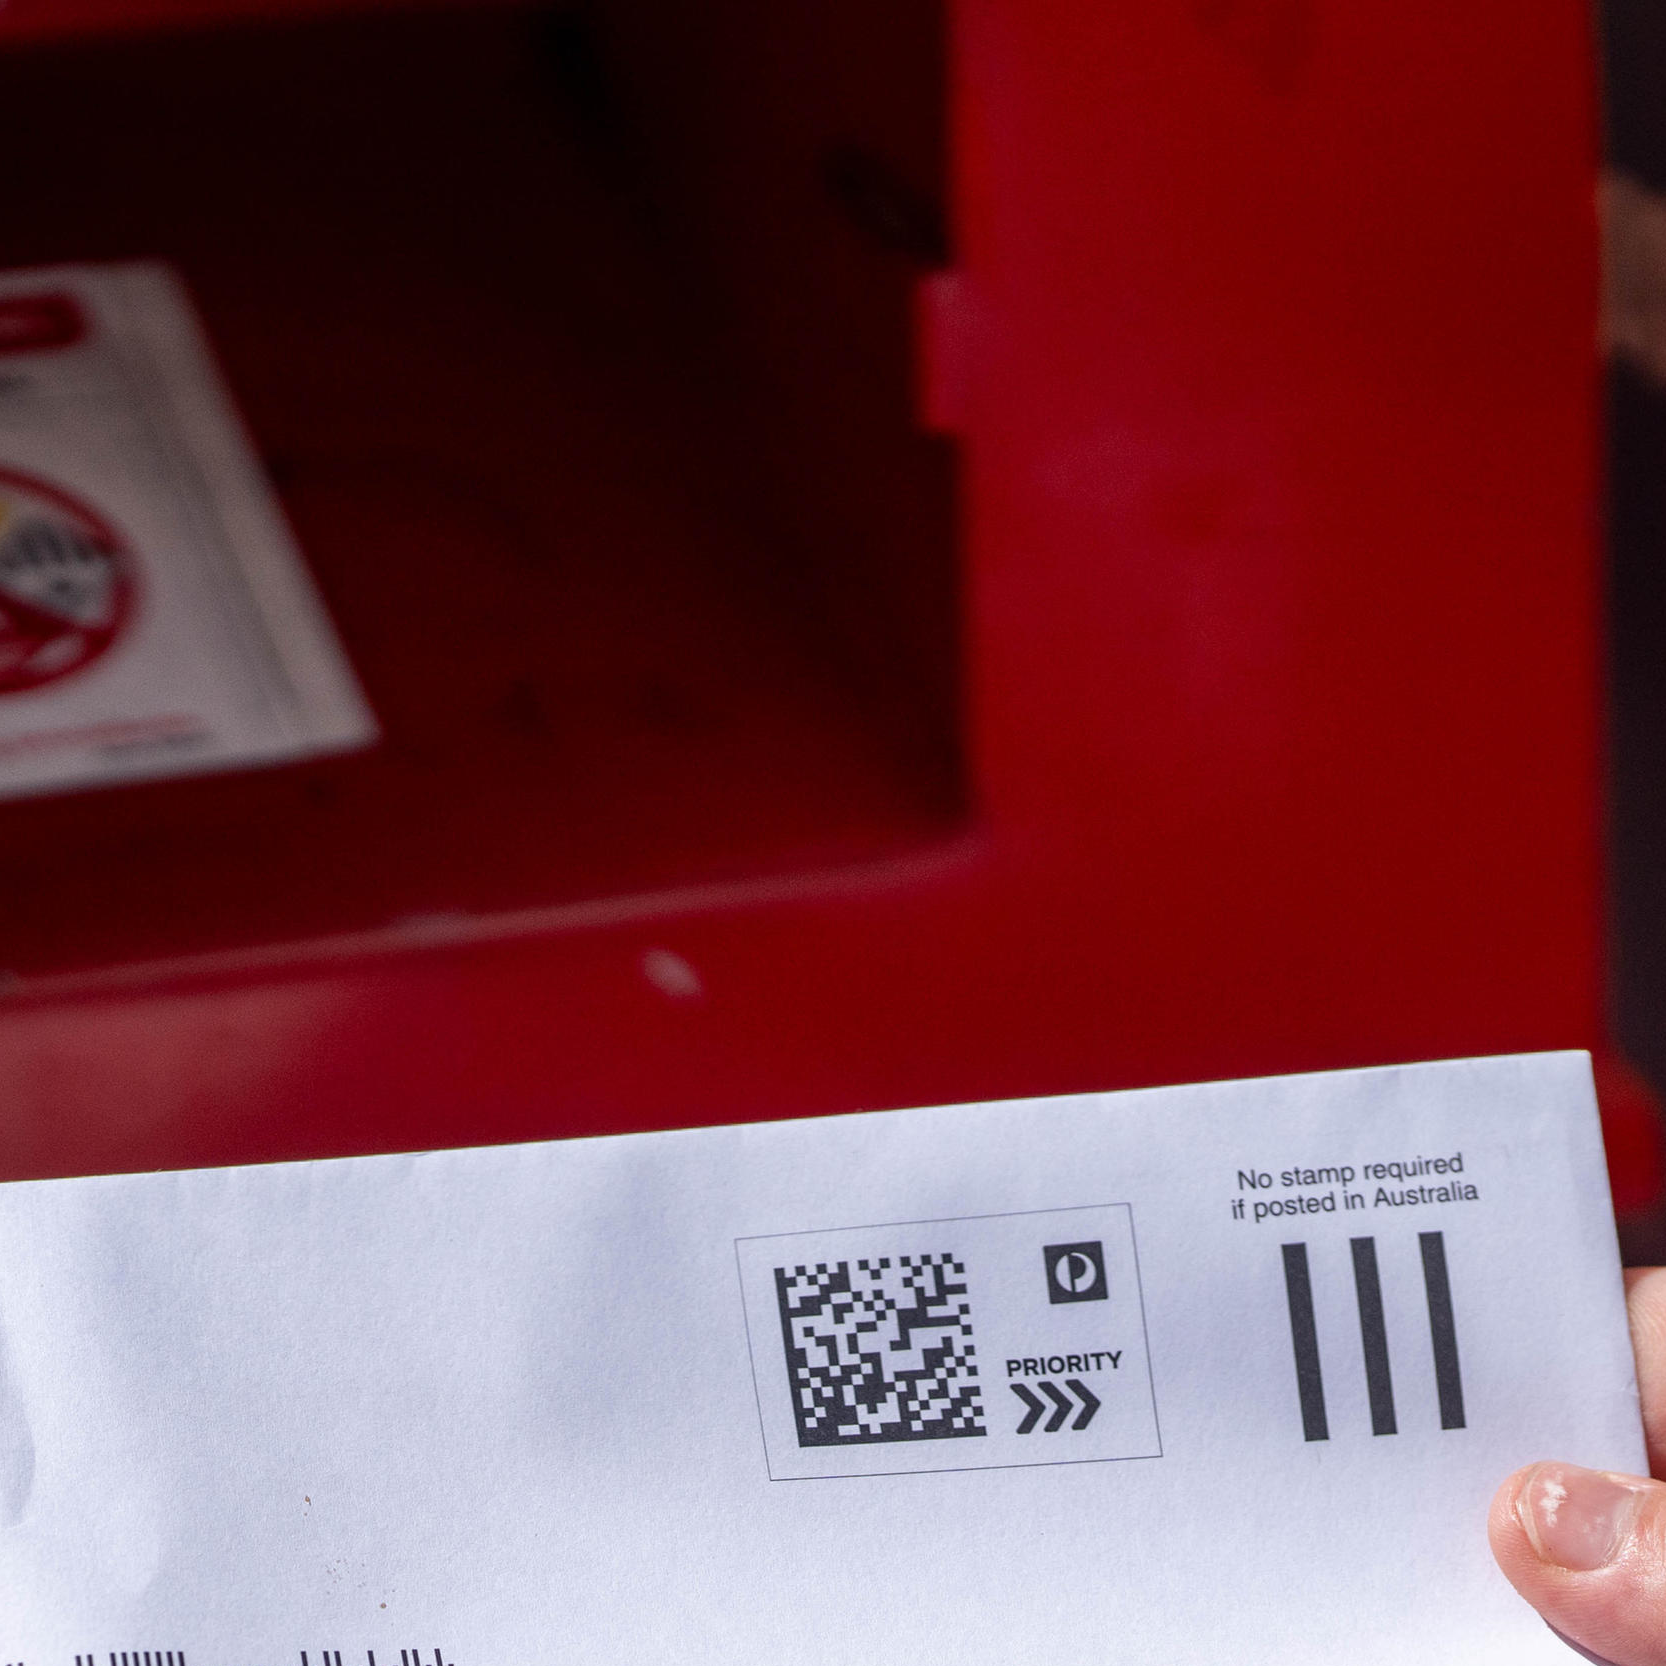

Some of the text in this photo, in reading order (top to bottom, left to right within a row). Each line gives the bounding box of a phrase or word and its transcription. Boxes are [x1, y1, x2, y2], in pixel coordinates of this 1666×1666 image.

[1237, 1151, 1464, 1191] No stamp required
[1231, 1181, 1480, 1224] if posted in Australia
[1006, 1350, 1122, 1378] PRIORITY
